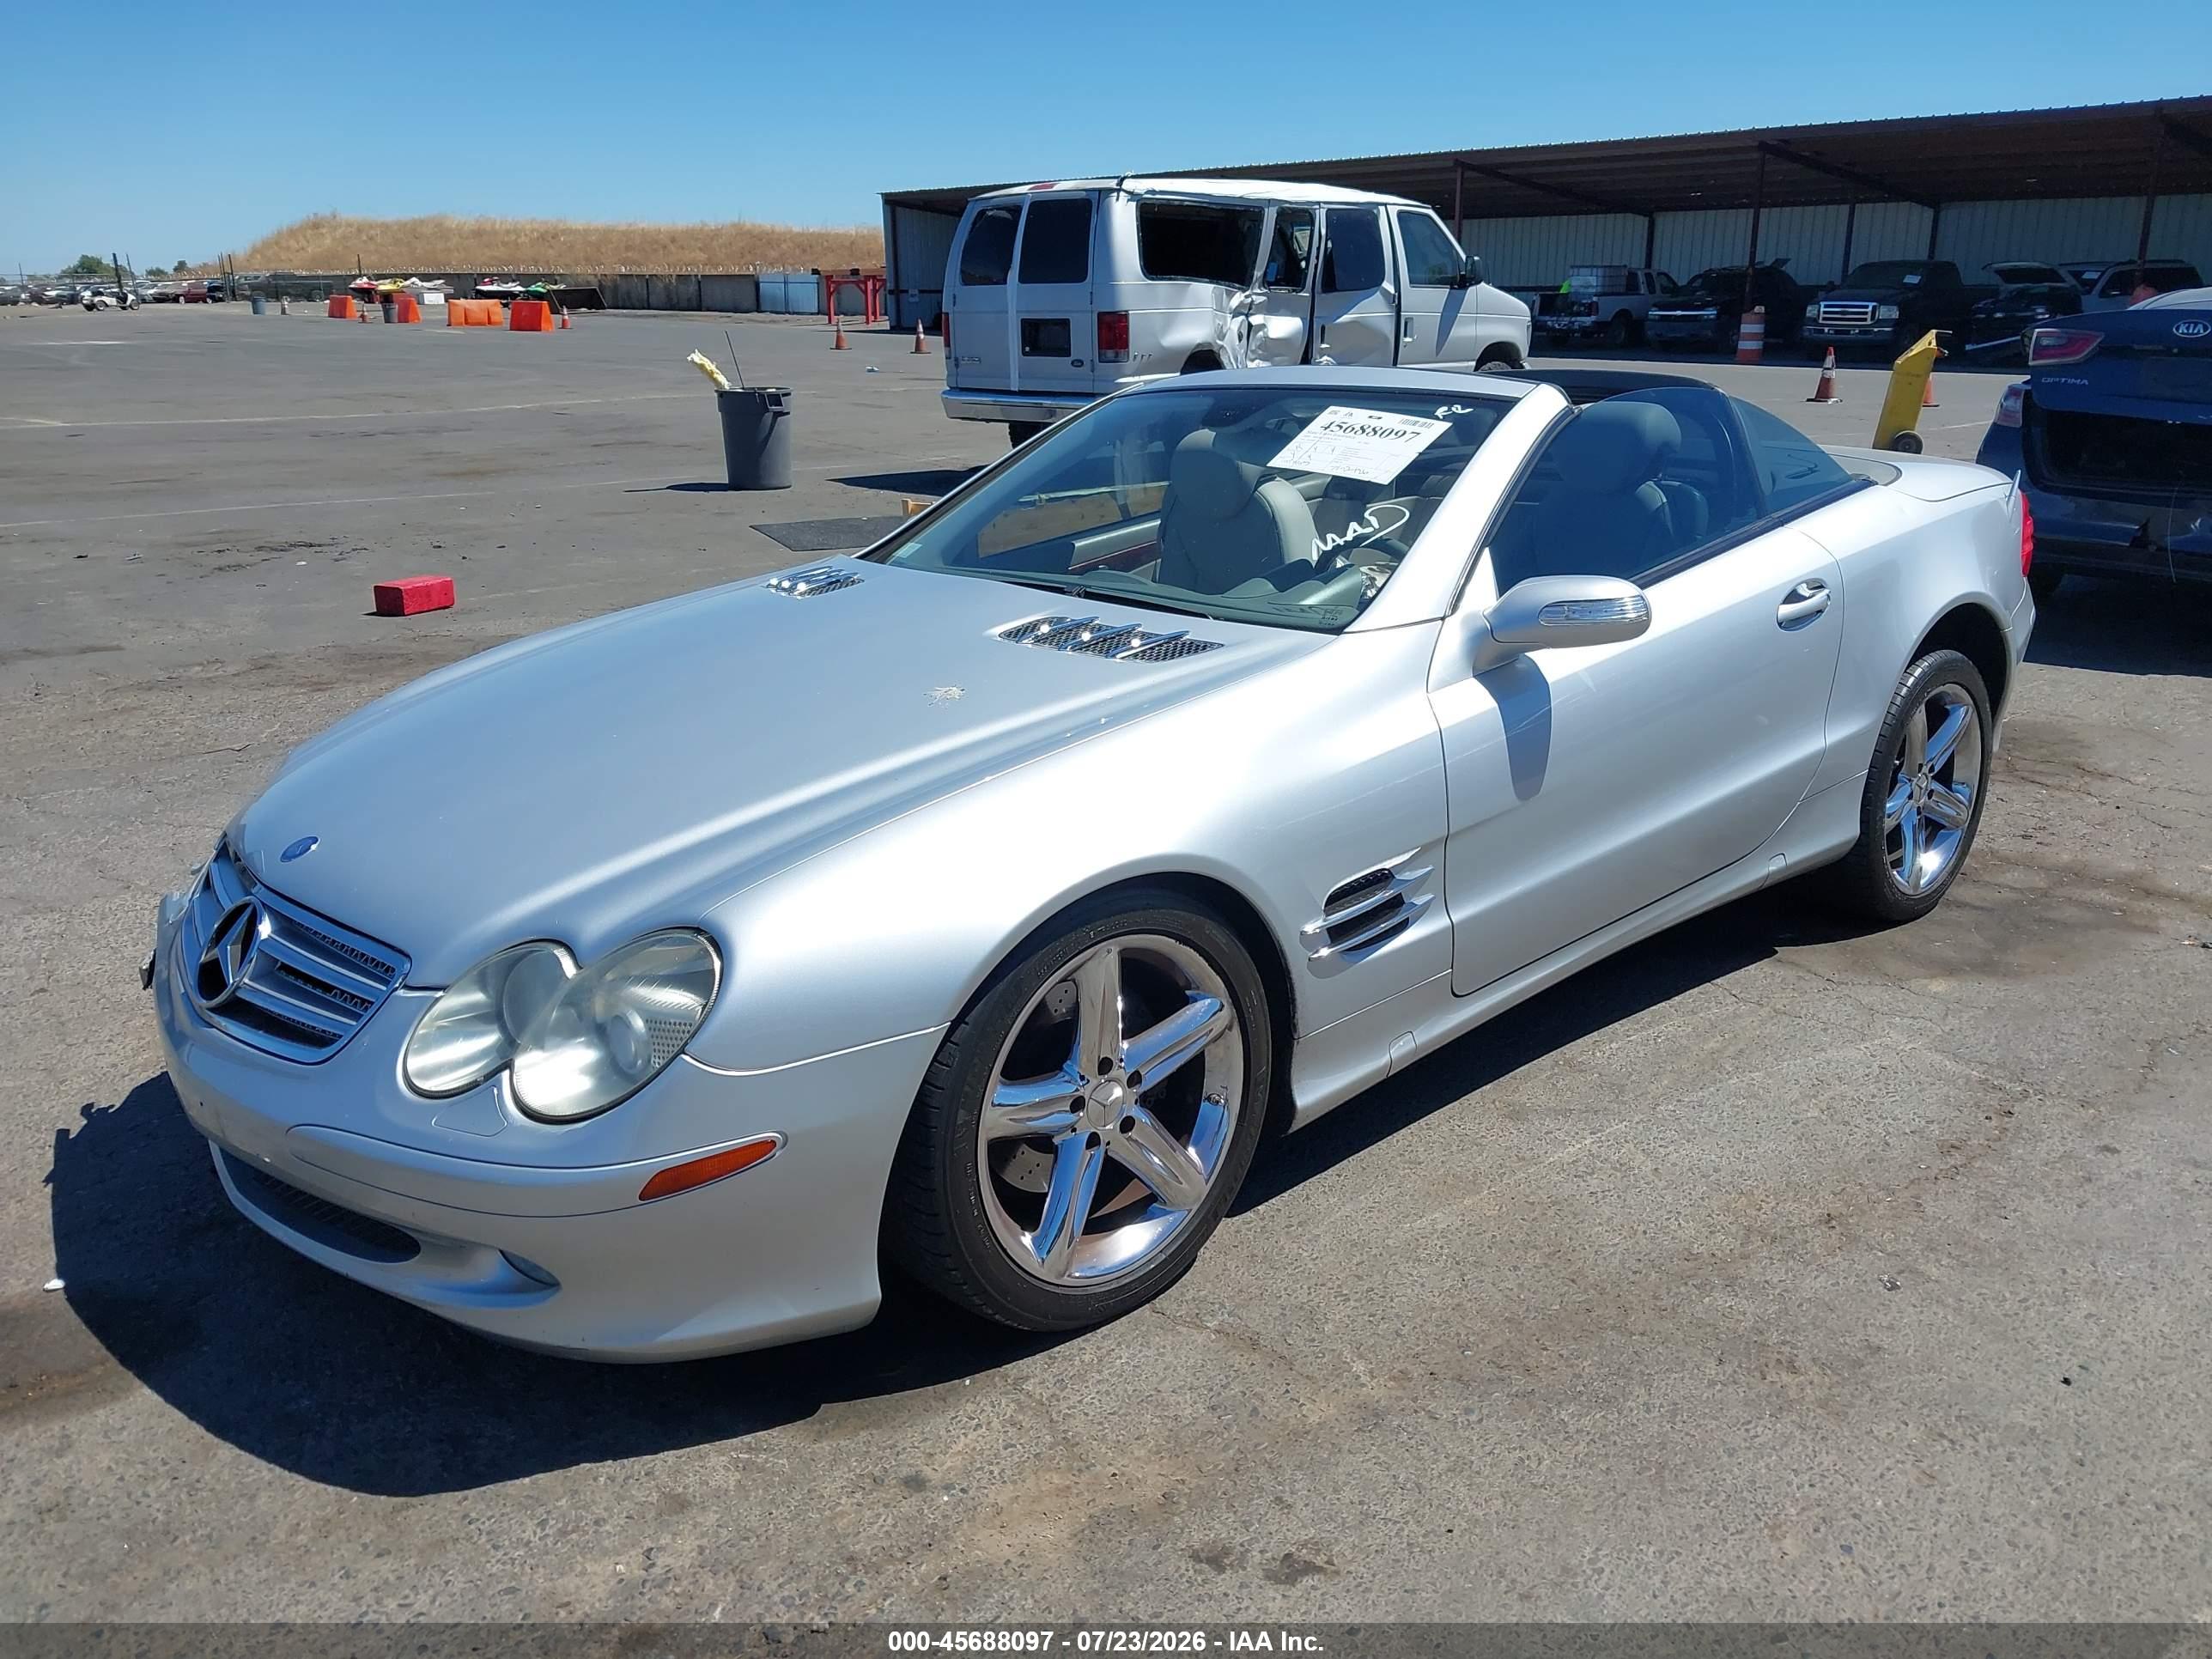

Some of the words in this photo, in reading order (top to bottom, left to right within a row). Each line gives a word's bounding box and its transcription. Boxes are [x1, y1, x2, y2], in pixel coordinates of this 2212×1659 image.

[2177, 321, 2205, 335] KIA
[2040, 377, 2089, 386] OPTIMA
[1320, 420, 1421, 443] 45688097
